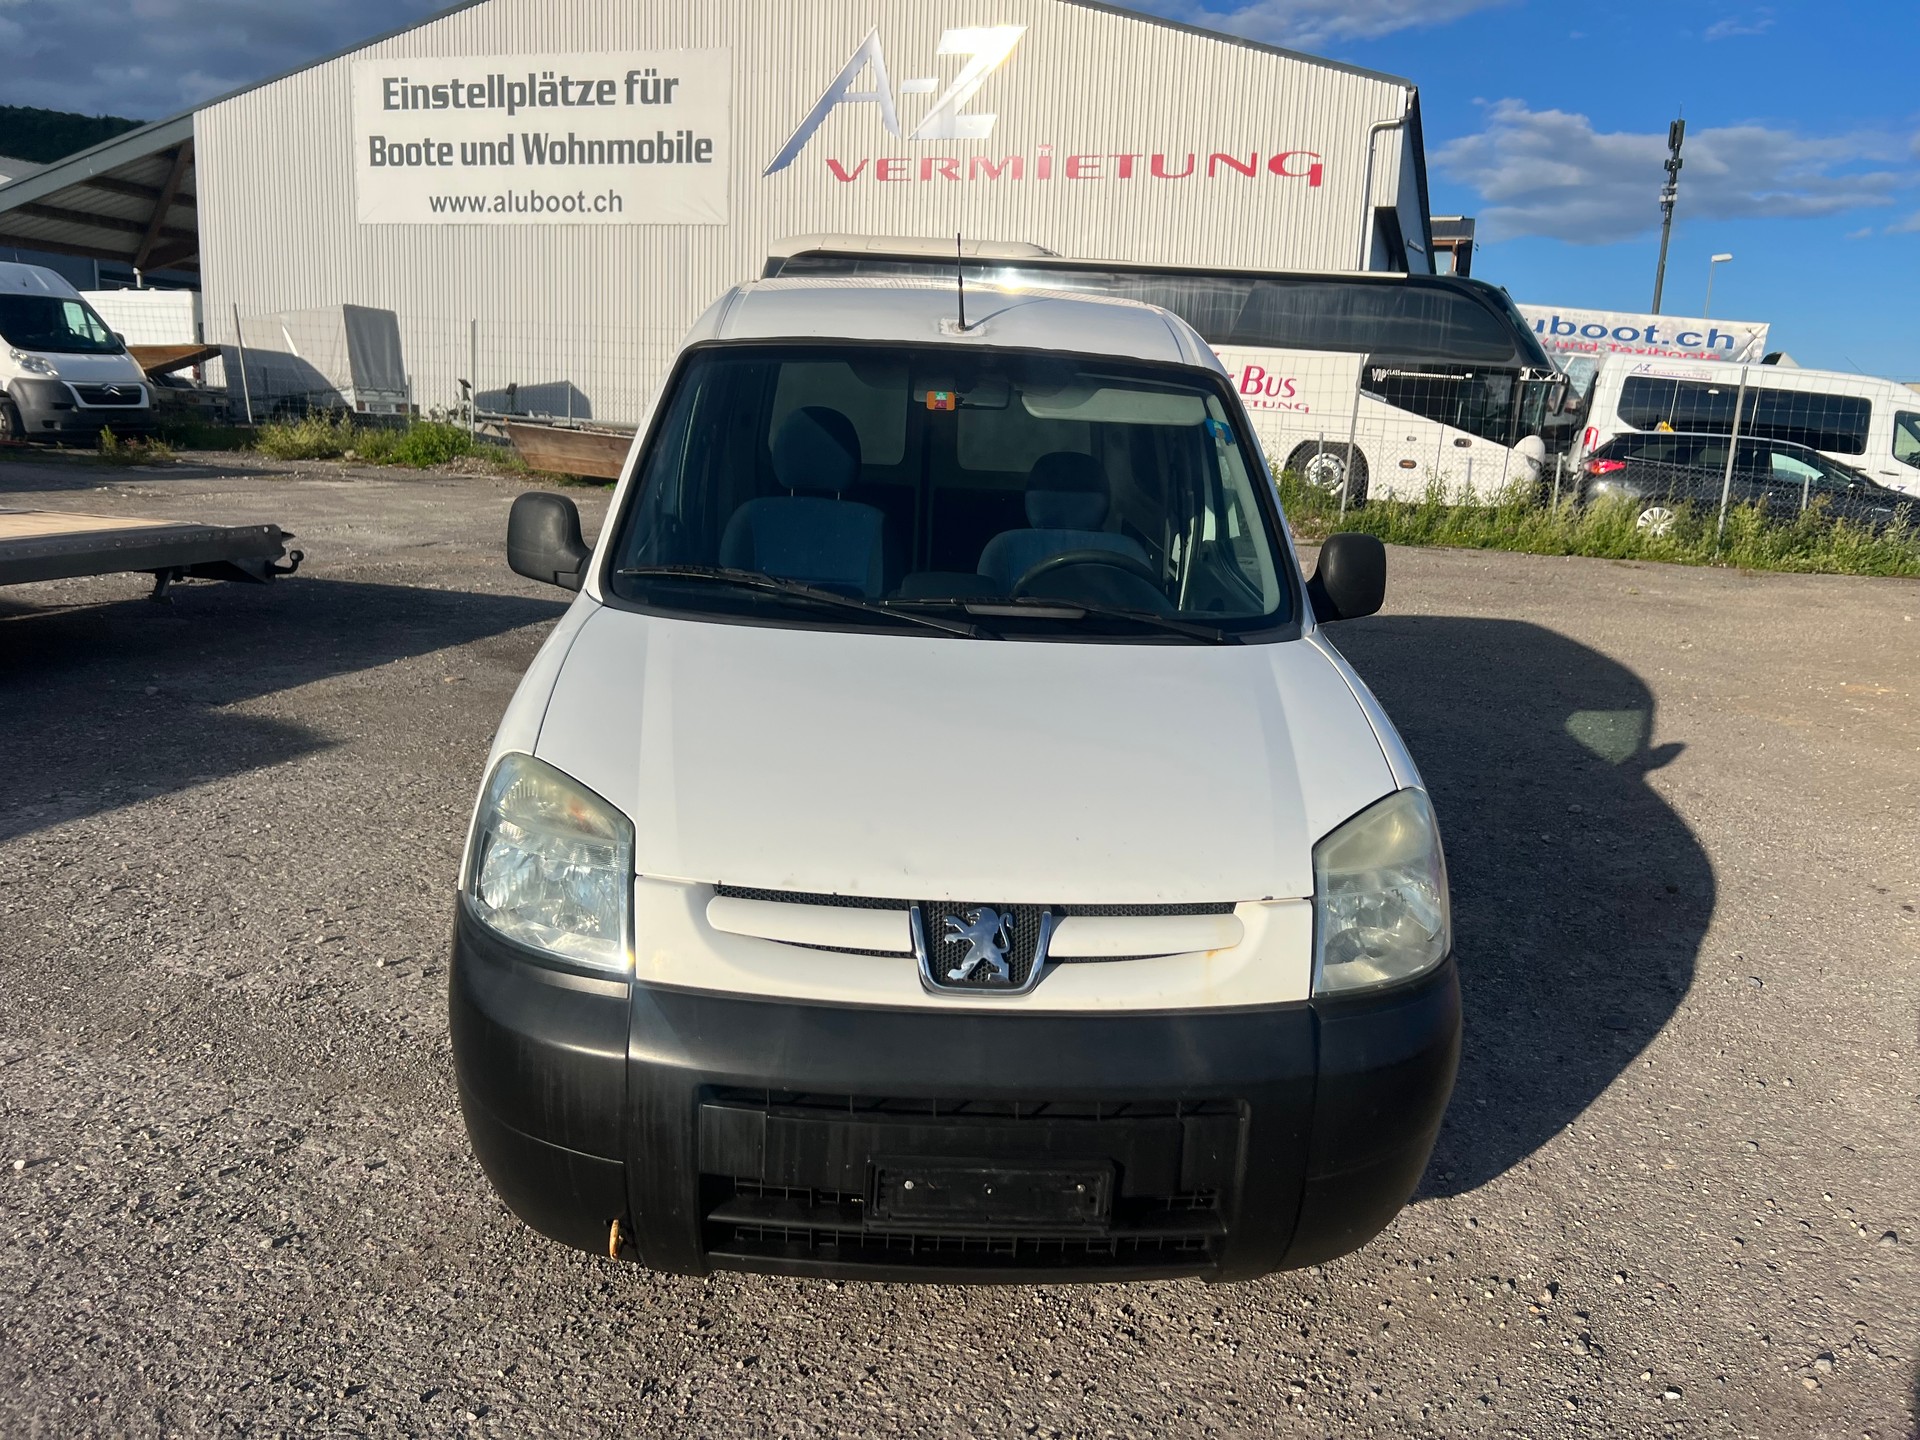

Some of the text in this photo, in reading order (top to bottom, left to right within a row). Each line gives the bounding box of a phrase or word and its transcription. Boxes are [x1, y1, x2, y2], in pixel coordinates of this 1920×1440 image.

[382, 68, 679, 116] Einstellplätze für
[762, 24, 1029, 178] A-Z
[369, 130, 713, 167] Boote und Wohnmobile
[429, 189, 623, 213] www.aluboot.ch
[1555, 340, 1598, 352] und
[1371, 368, 1401, 382] VIP CLASS
[1242, 399, 1310, 413] ETUNG
